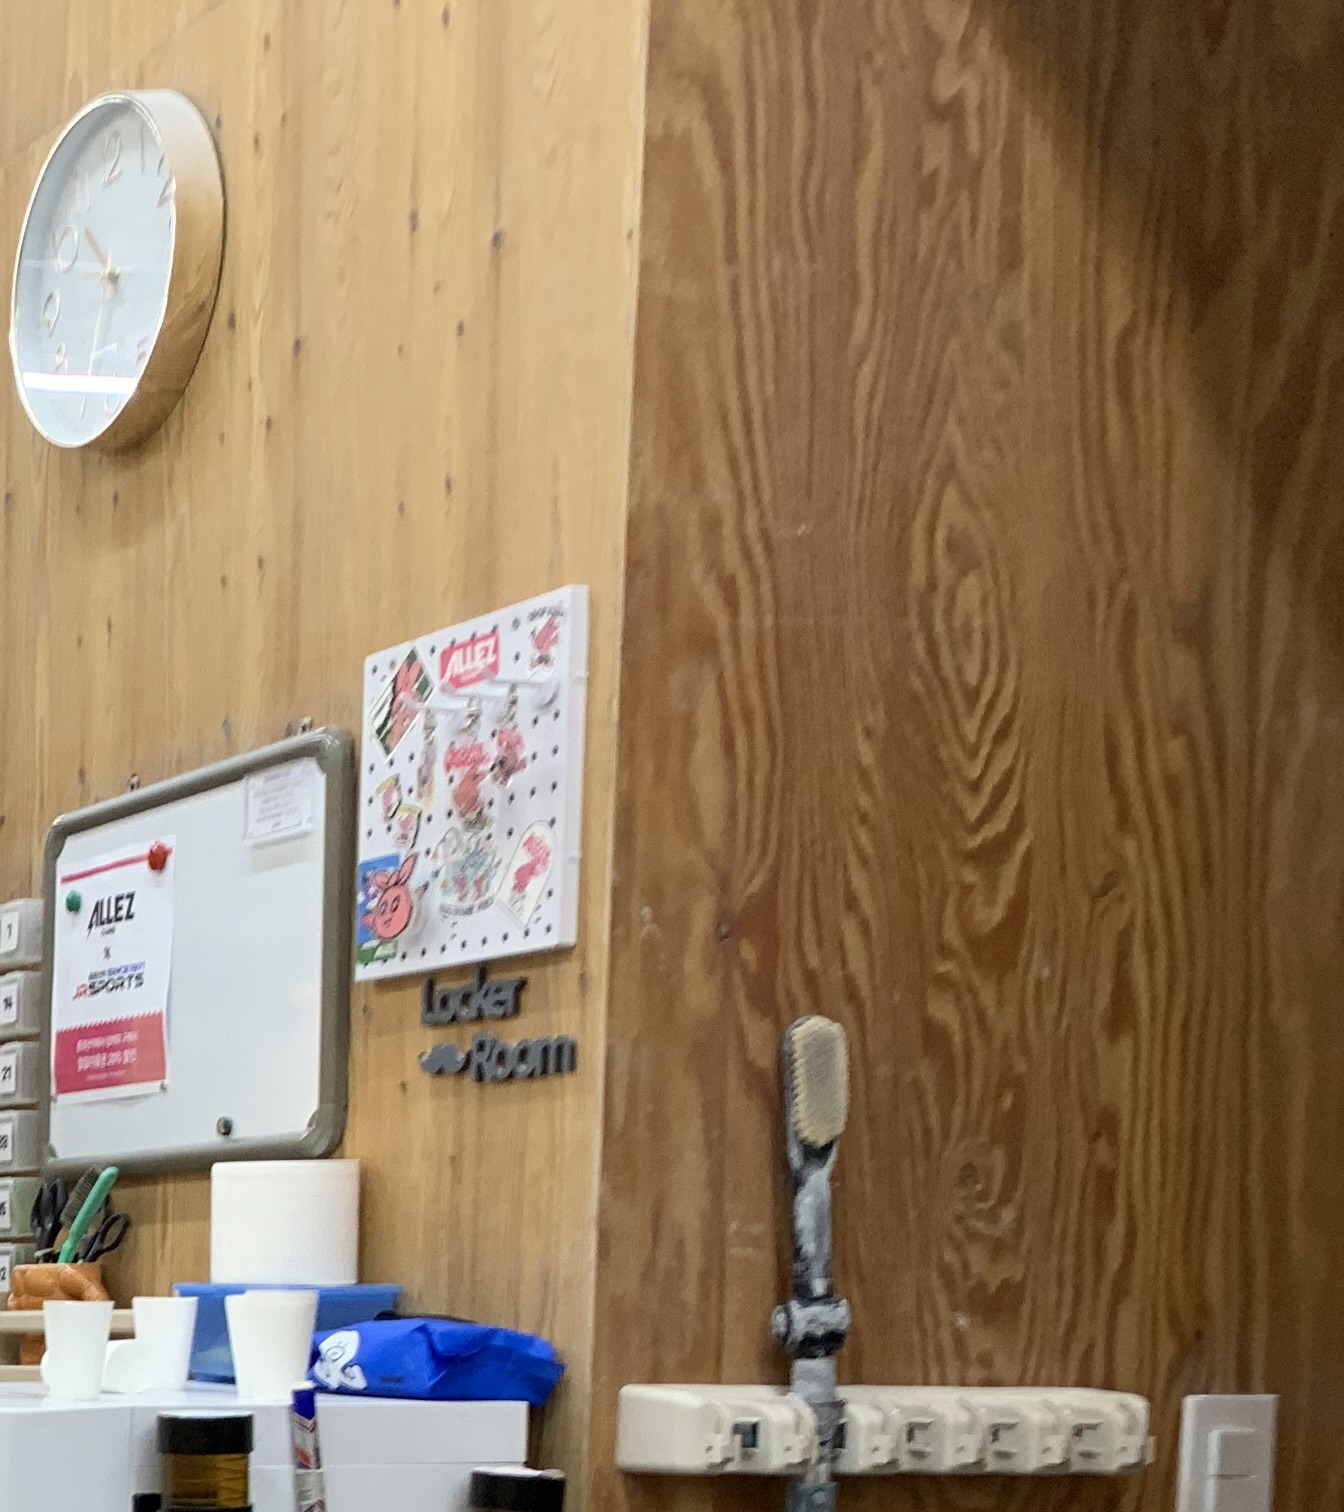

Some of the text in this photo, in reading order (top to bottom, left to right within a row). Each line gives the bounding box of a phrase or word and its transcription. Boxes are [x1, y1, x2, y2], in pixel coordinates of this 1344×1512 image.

[443, 636, 498, 681] ALLEZ
[7, 923, 12, 939] 7
[87, 891, 136, 939] ALLEZ
[4, 996, 13, 1011] 14
[422, 962, 528, 1026] Locker
[1, 1065, 12, 1081] 21
[472, 1033, 577, 1083] Room
